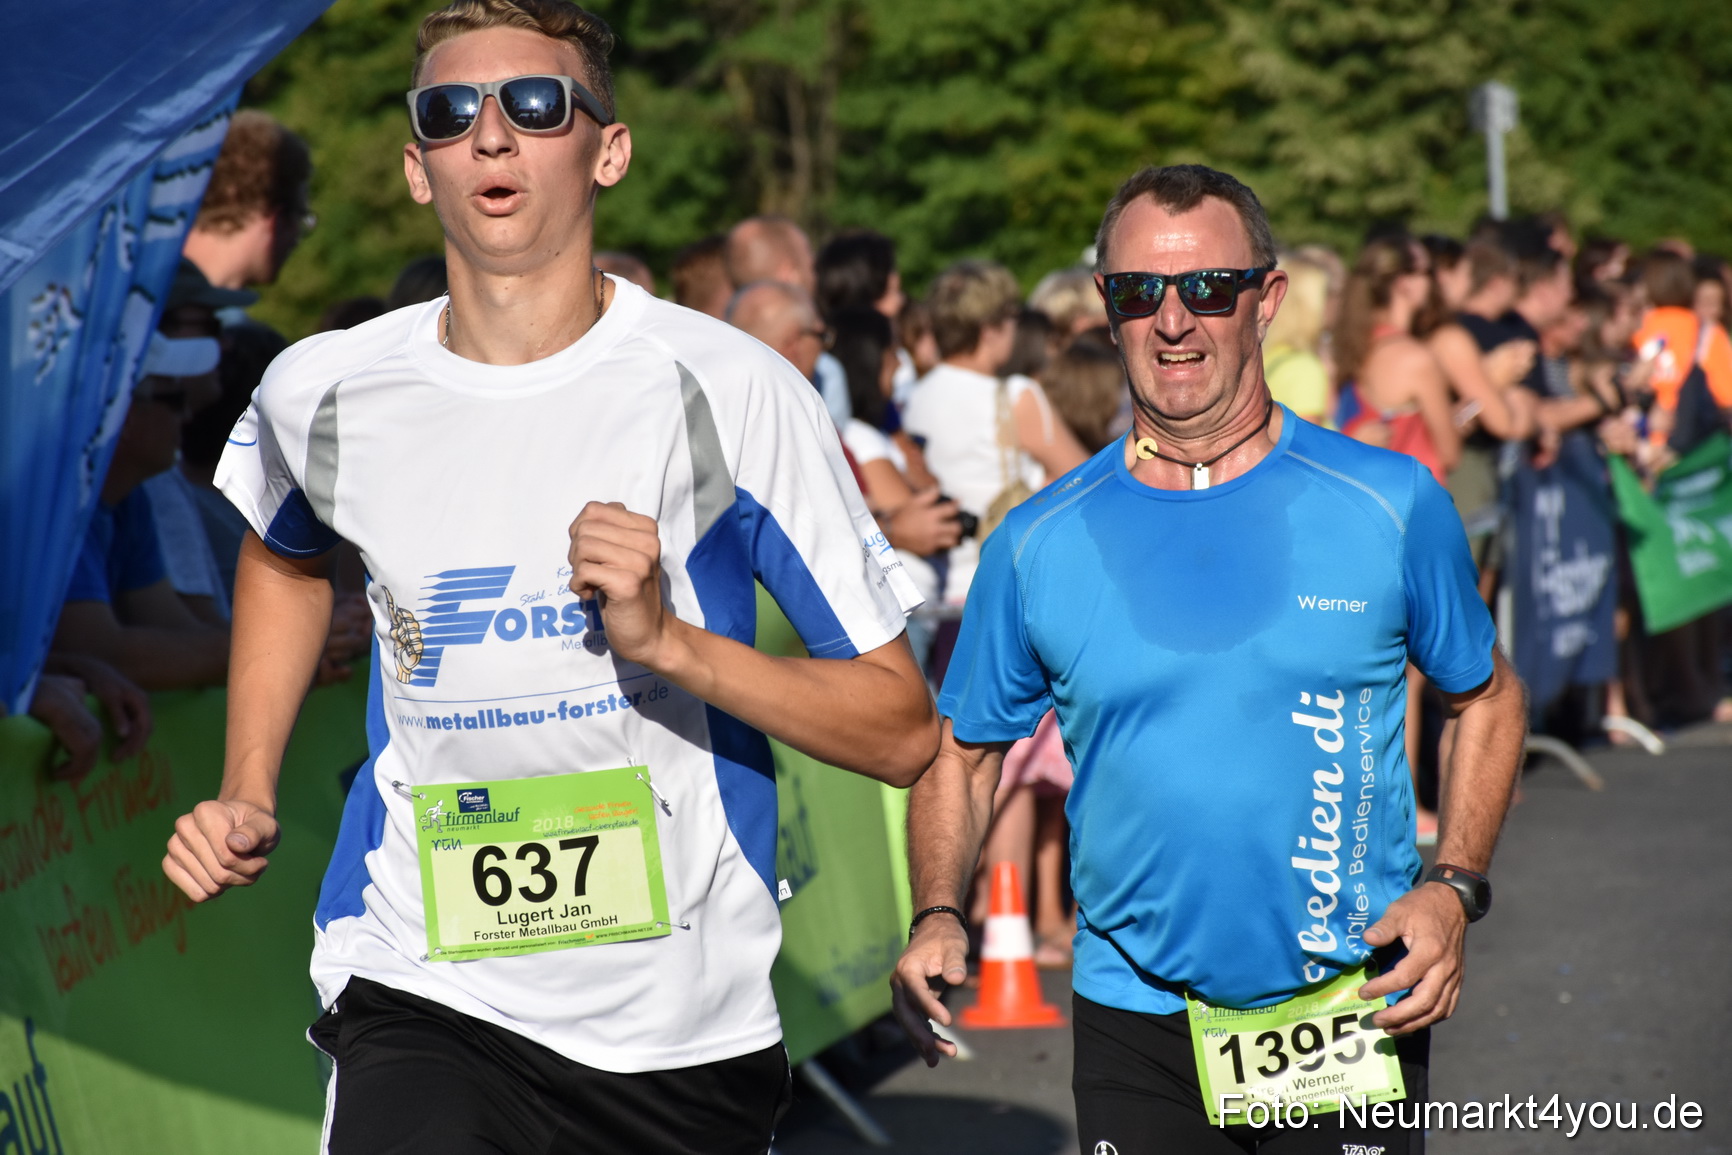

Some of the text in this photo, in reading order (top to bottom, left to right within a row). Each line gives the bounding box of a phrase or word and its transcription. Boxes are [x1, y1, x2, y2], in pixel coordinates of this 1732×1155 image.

[1298, 594, 1368, 614] Werner
[561, 635, 609, 653] Metallb
[397, 680, 669, 731] www.metallbau-forster.de
[1291, 689, 1345, 754] di
[1349, 687, 1374, 876] Bedienservice
[446, 807, 520, 825] firmenlauf
[532, 815, 574, 832] 2018
[472, 834, 600, 907] 637
[1291, 762, 1343, 954] bedien
[497, 903, 592, 928] Lugert Jan
[474, 915, 618, 942] Forster Metallbau GmbH
[1288, 1001, 1319, 1018] 2018
[1219, 1013, 1367, 1084] 1395
[1289, 1084, 1355, 1103] Lengenfelder
[1294, 1071, 1347, 1091] Werner
